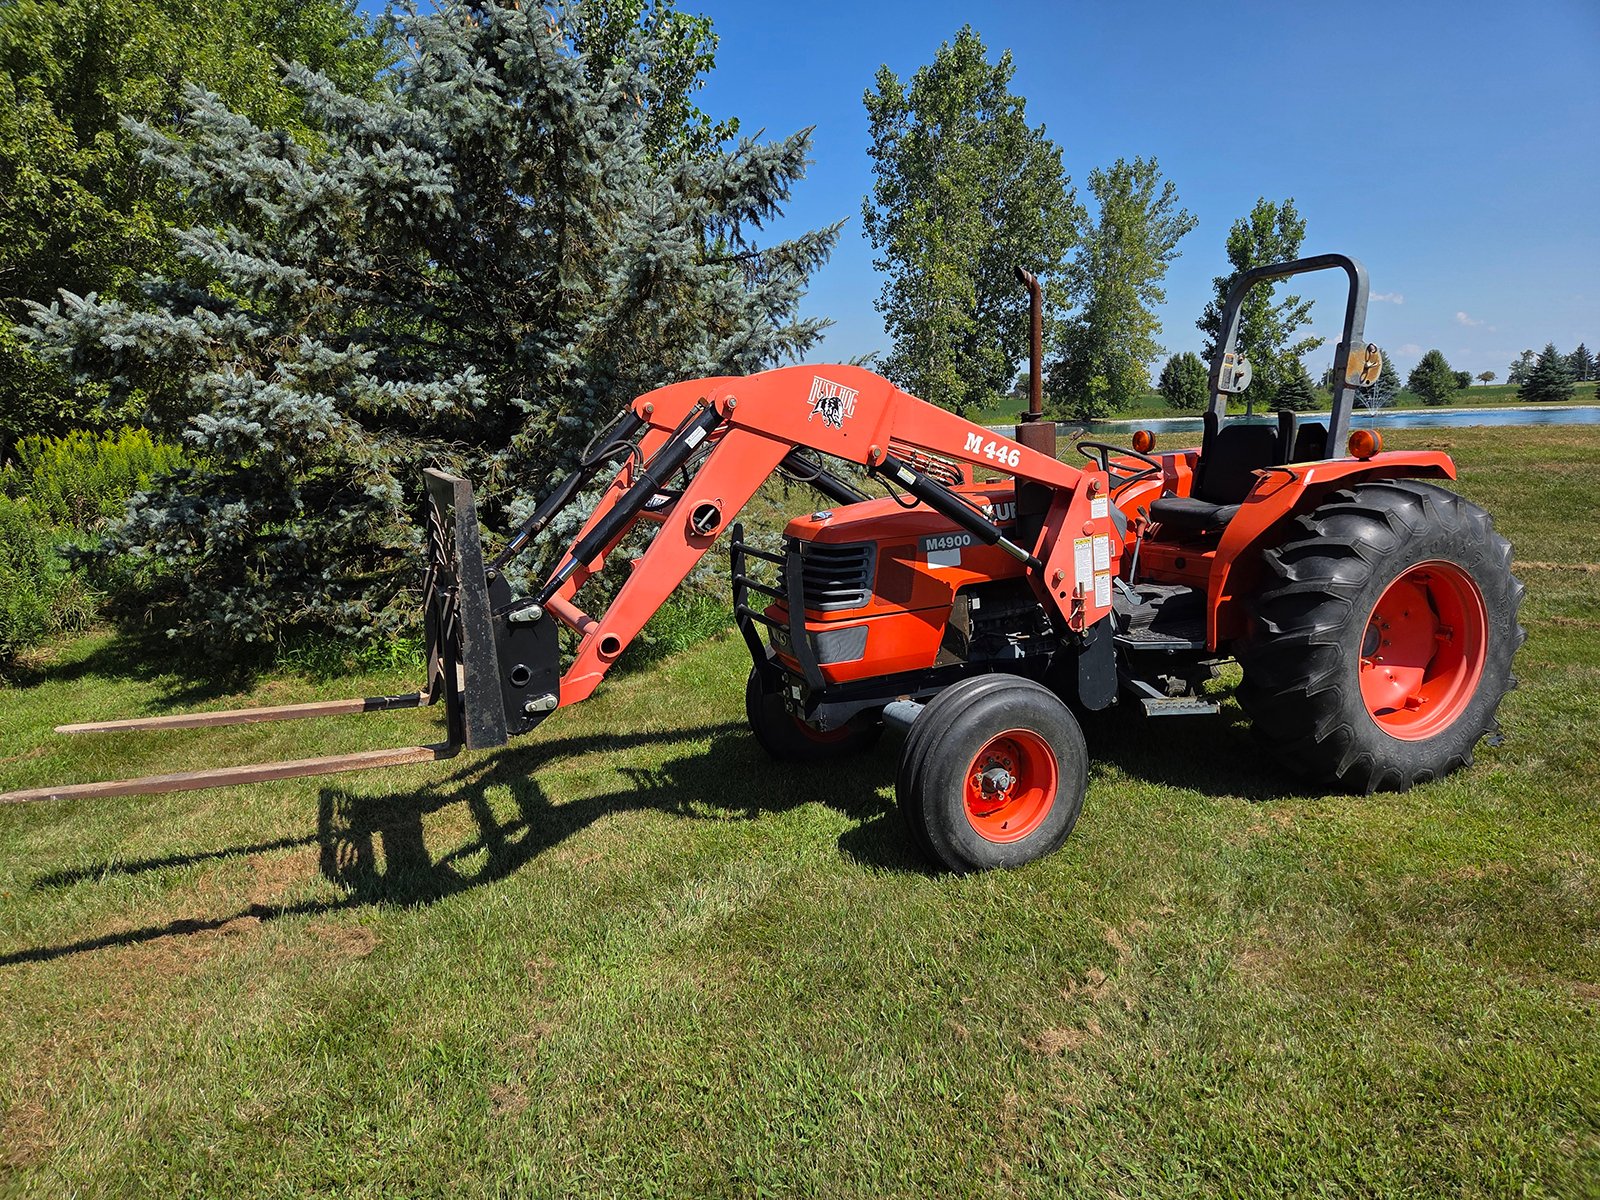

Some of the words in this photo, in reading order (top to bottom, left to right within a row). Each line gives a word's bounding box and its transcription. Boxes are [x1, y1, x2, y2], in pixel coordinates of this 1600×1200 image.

[808, 378, 838, 402] BUSH
[838, 387, 860, 416] HOG
[983, 441, 1021, 468] 446
[926, 534, 971, 551] M4900
